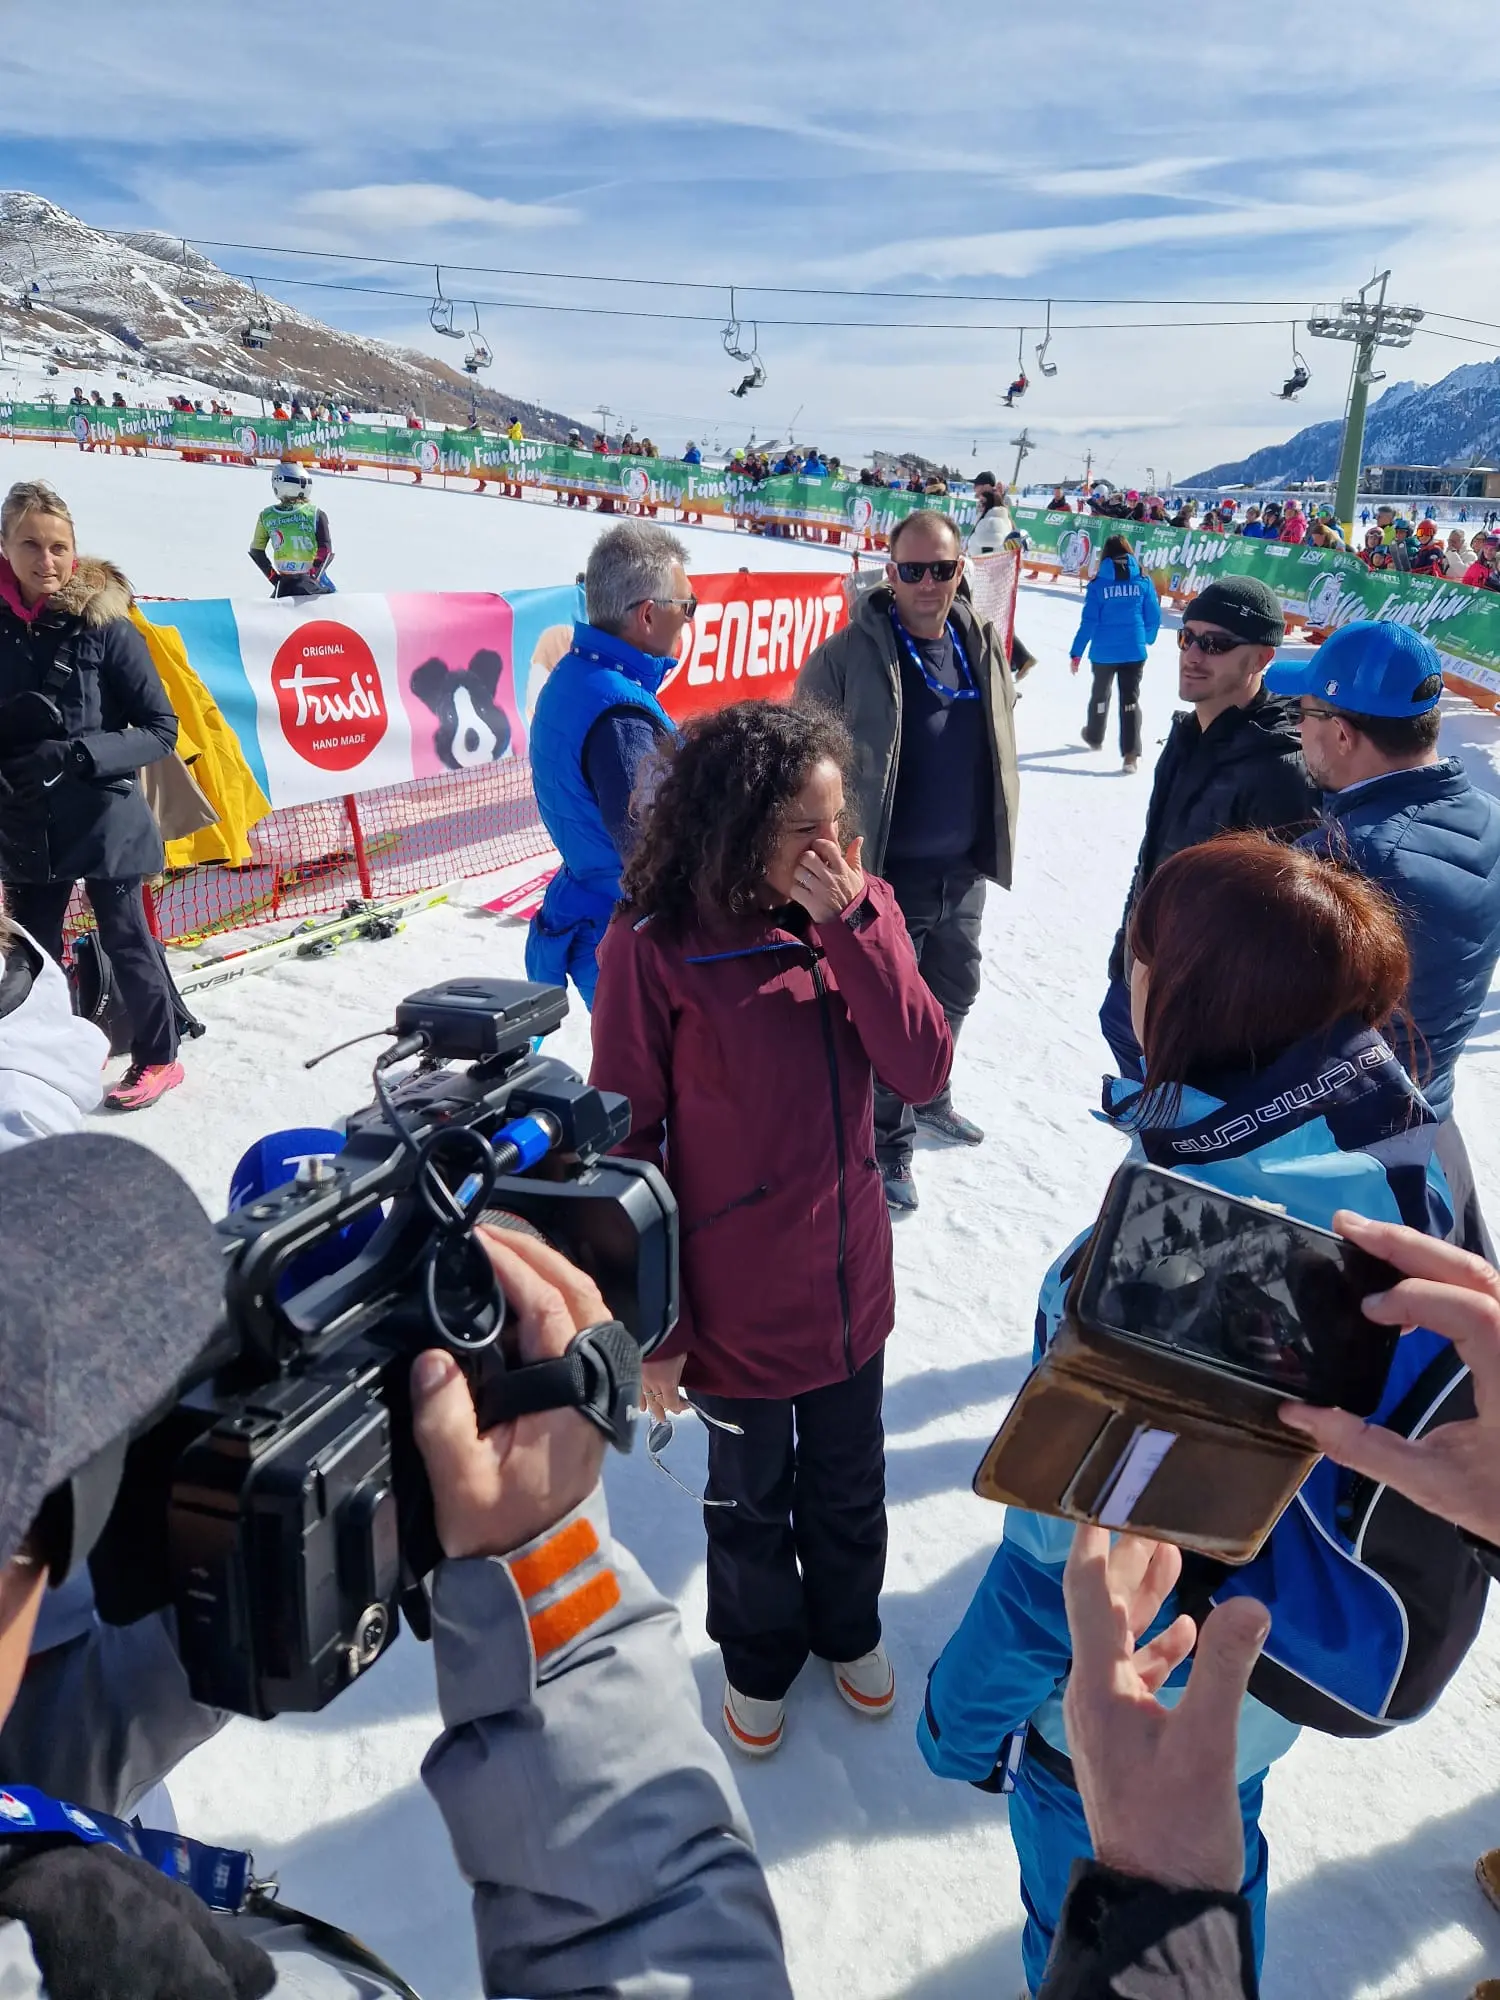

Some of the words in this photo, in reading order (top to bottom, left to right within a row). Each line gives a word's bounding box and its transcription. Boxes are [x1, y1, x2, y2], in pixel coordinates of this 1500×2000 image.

[117, 409, 174, 437] Fanchini
[286, 420, 347, 450] Fanchini
[474, 439, 546, 468] Fanchini
[1134, 531, 1232, 571] Fanchini
[1103, 583, 1141, 600] ITALIA
[302, 643, 345, 658] ORIGINAL
[686, 594, 843, 687] ENERVIT
[312, 737, 339, 751] HAND
[340, 733, 366, 748] MADE
[179, 967, 245, 996] HEAD
